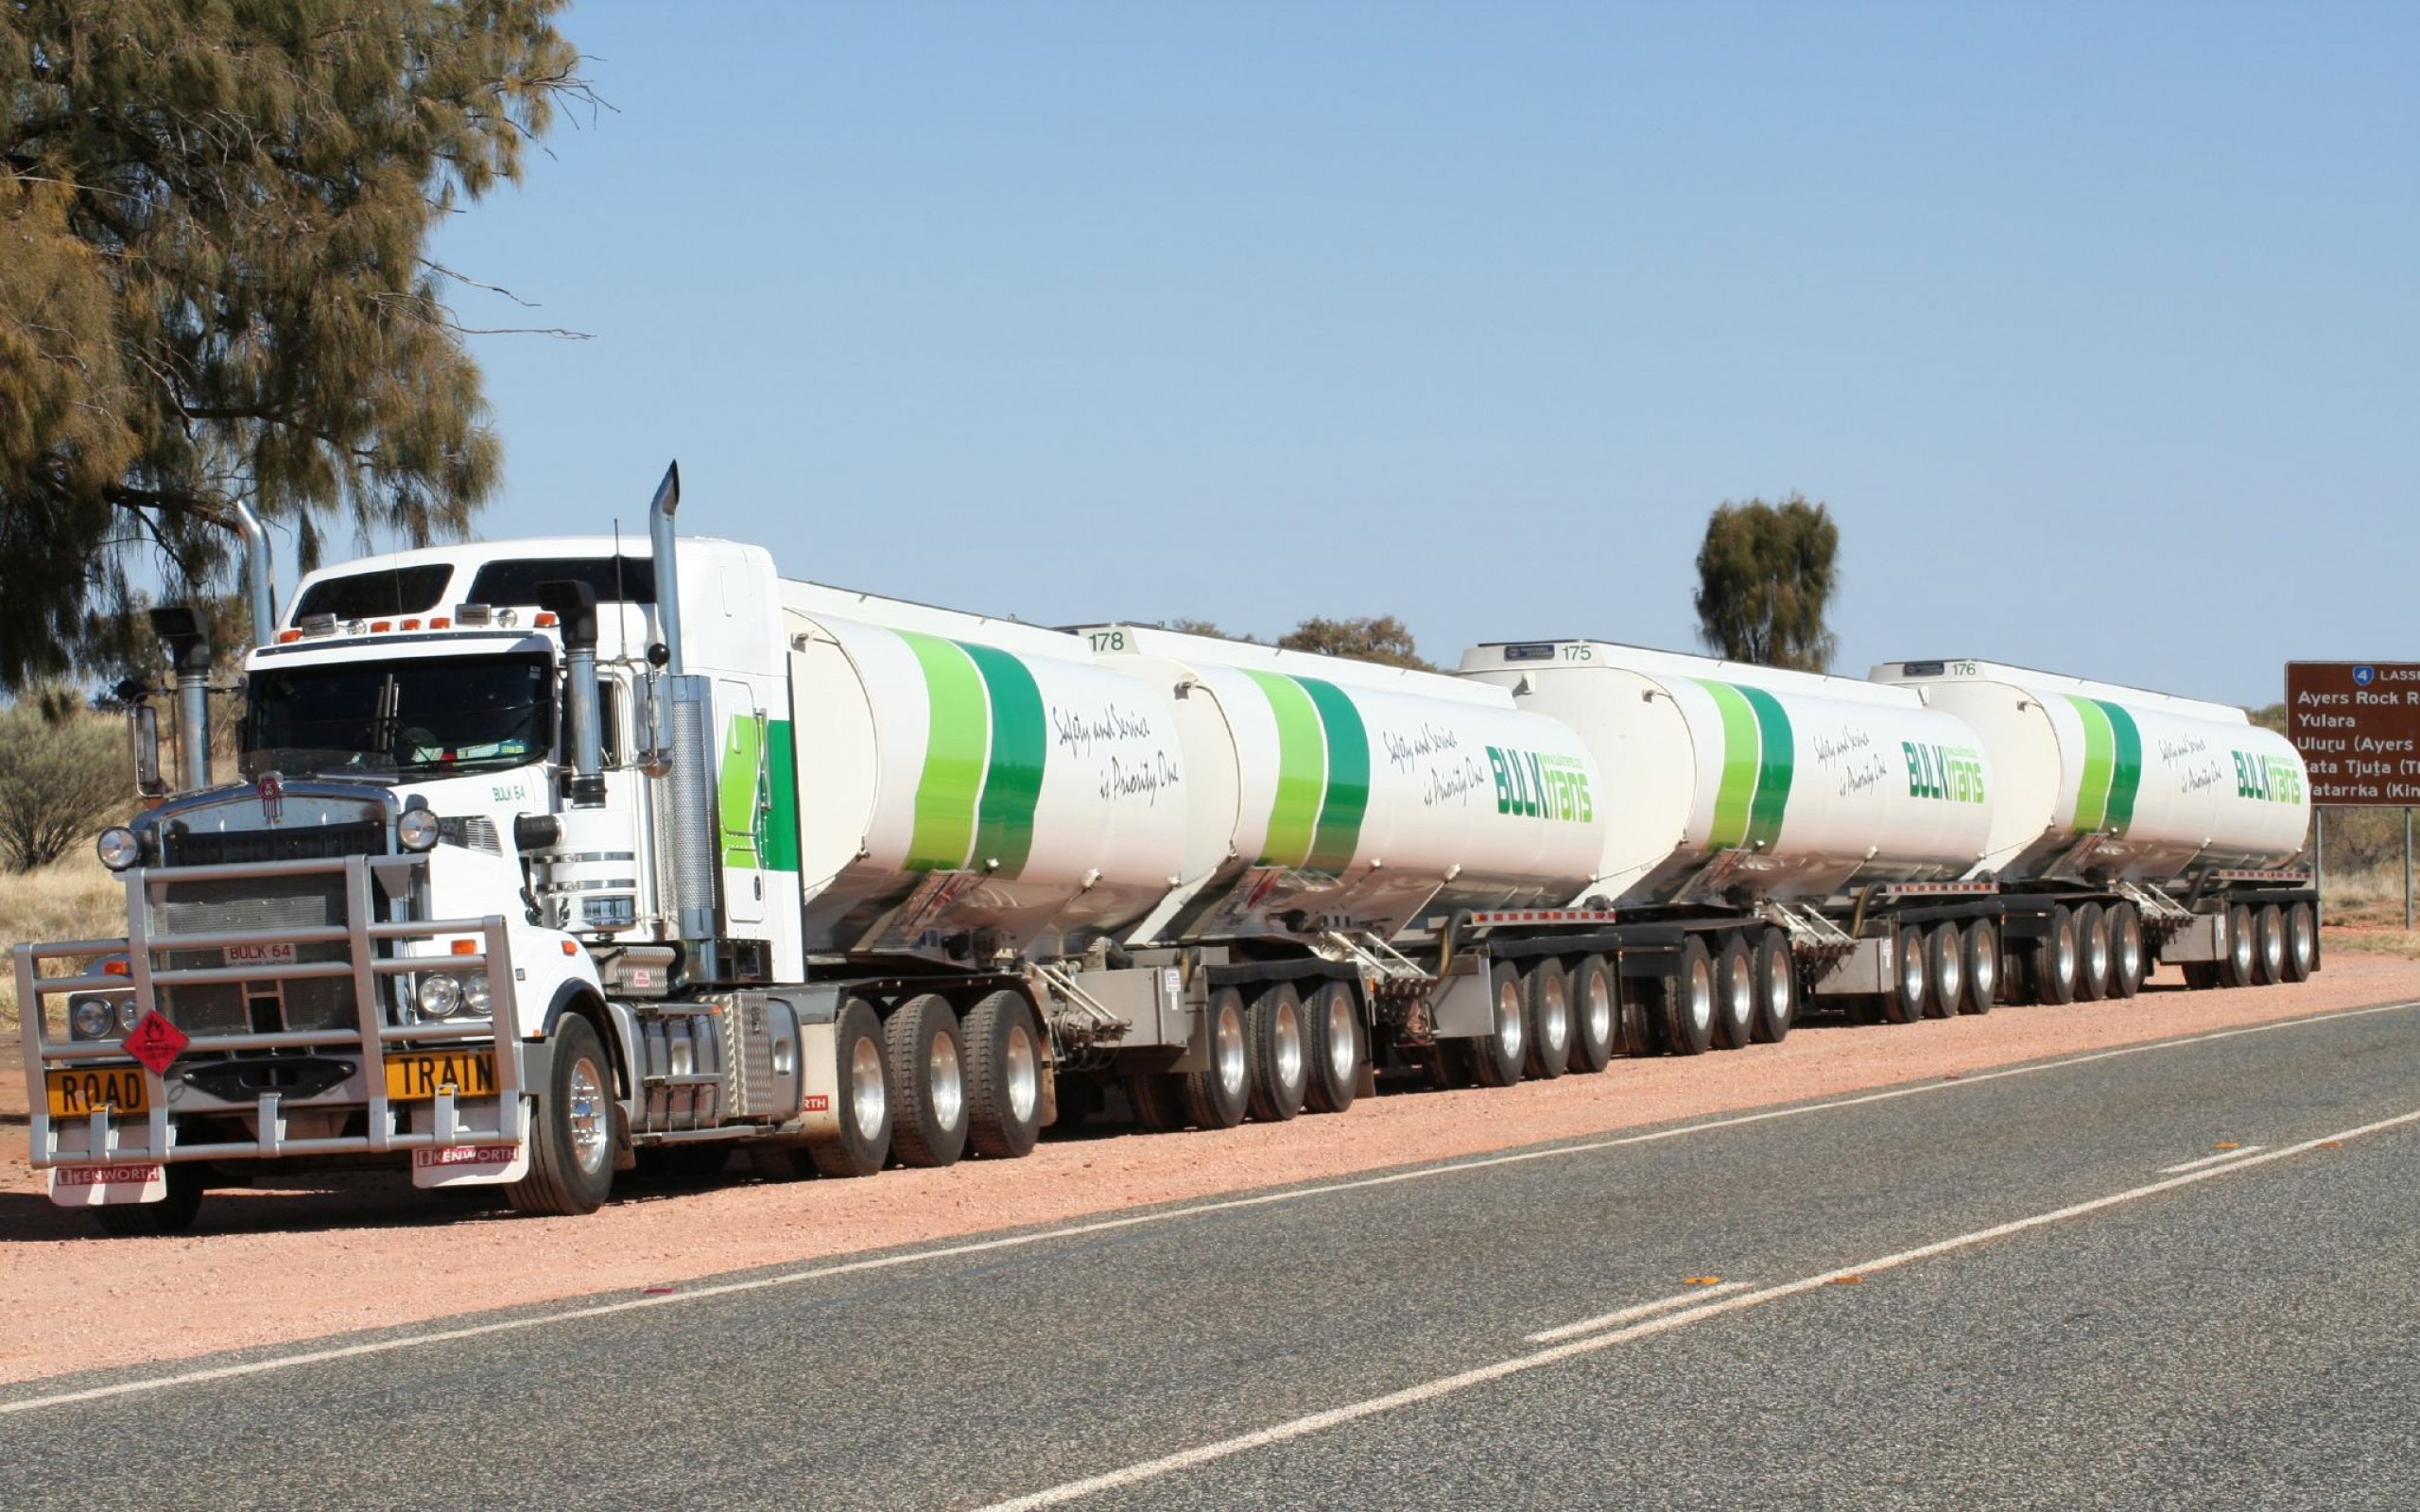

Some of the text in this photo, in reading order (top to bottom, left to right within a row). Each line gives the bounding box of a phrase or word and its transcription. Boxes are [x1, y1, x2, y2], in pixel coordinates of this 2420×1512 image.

[1088, 631, 1125, 652] 178
[1562, 645, 1592, 661] 175
[1952, 662, 1977, 676] 176
[2357, 669, 2368, 681] 4
[2298, 691, 2420, 707] Ayers Rock R
[2298, 713, 2356, 728] Yulara
[2354, 735, 2413, 754] (Ayers
[492, 785, 526, 801] BULK 64
[2309, 782, 2420, 799] atarrka (Kin
[230, 944, 291, 960] BULK 64
[399, 1054, 493, 1095] TRAIN
[61, 1072, 141, 1112] ROAD
[433, 1148, 519, 1163] KENWORTH
[73, 1166, 160, 1183] KENWORTH
